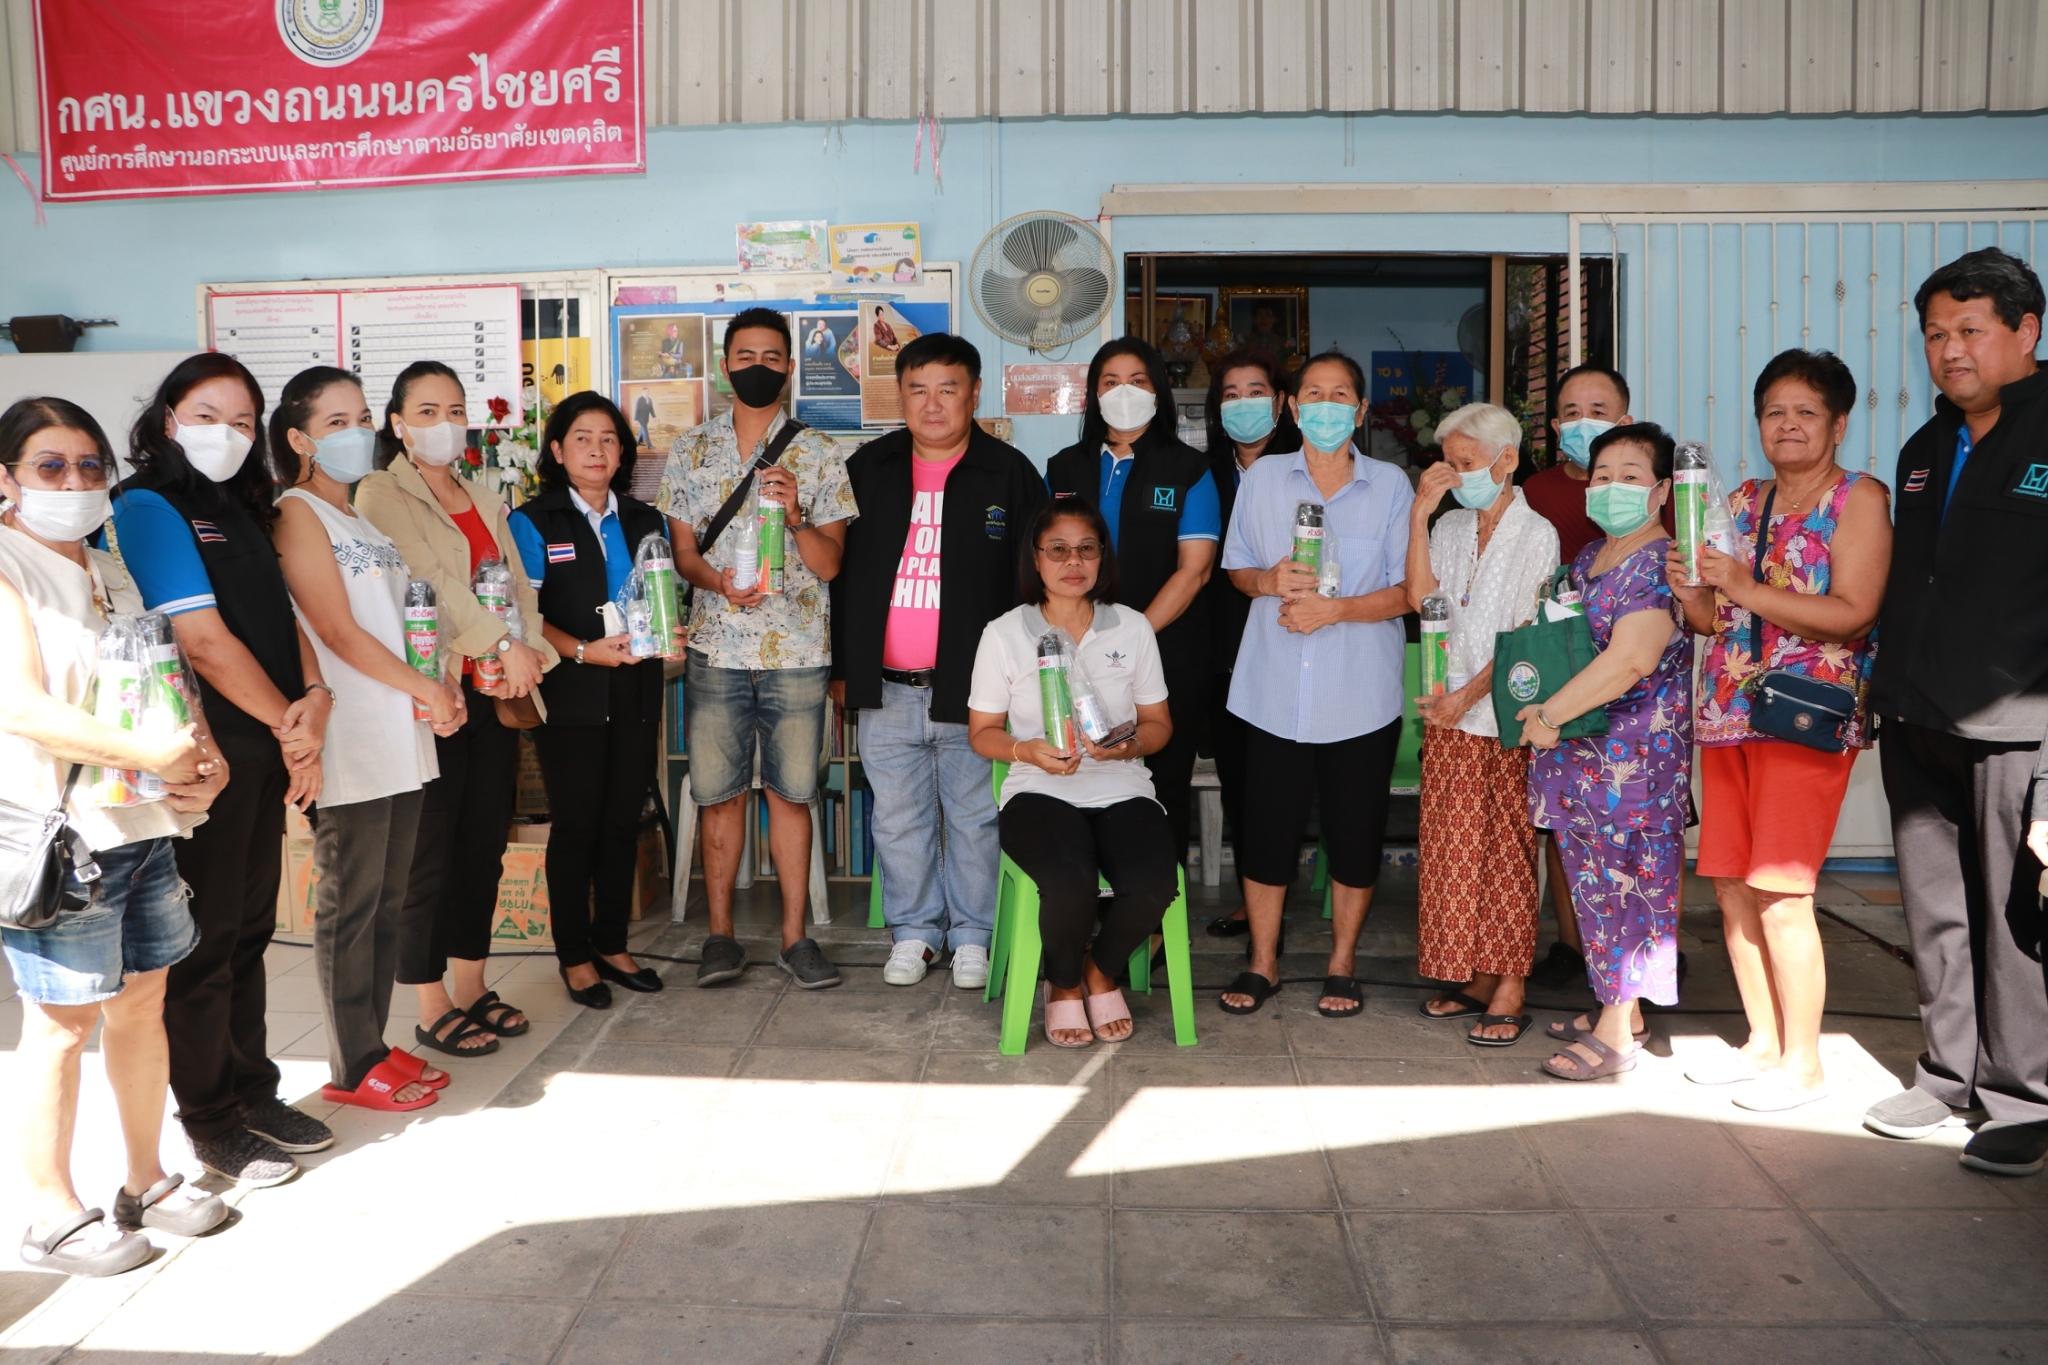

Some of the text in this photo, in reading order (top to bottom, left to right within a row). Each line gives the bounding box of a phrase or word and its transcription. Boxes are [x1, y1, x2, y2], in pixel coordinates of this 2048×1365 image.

[58, 46, 622, 133] กศน.แขวงถนนนครไชยศรี
[60, 118, 622, 181] ศูนย์การศึกษานอกระบบและการศึกษาตามอัธยาศัยเขตดุสิต
[497, 878, 530, 888] แมลงสา
